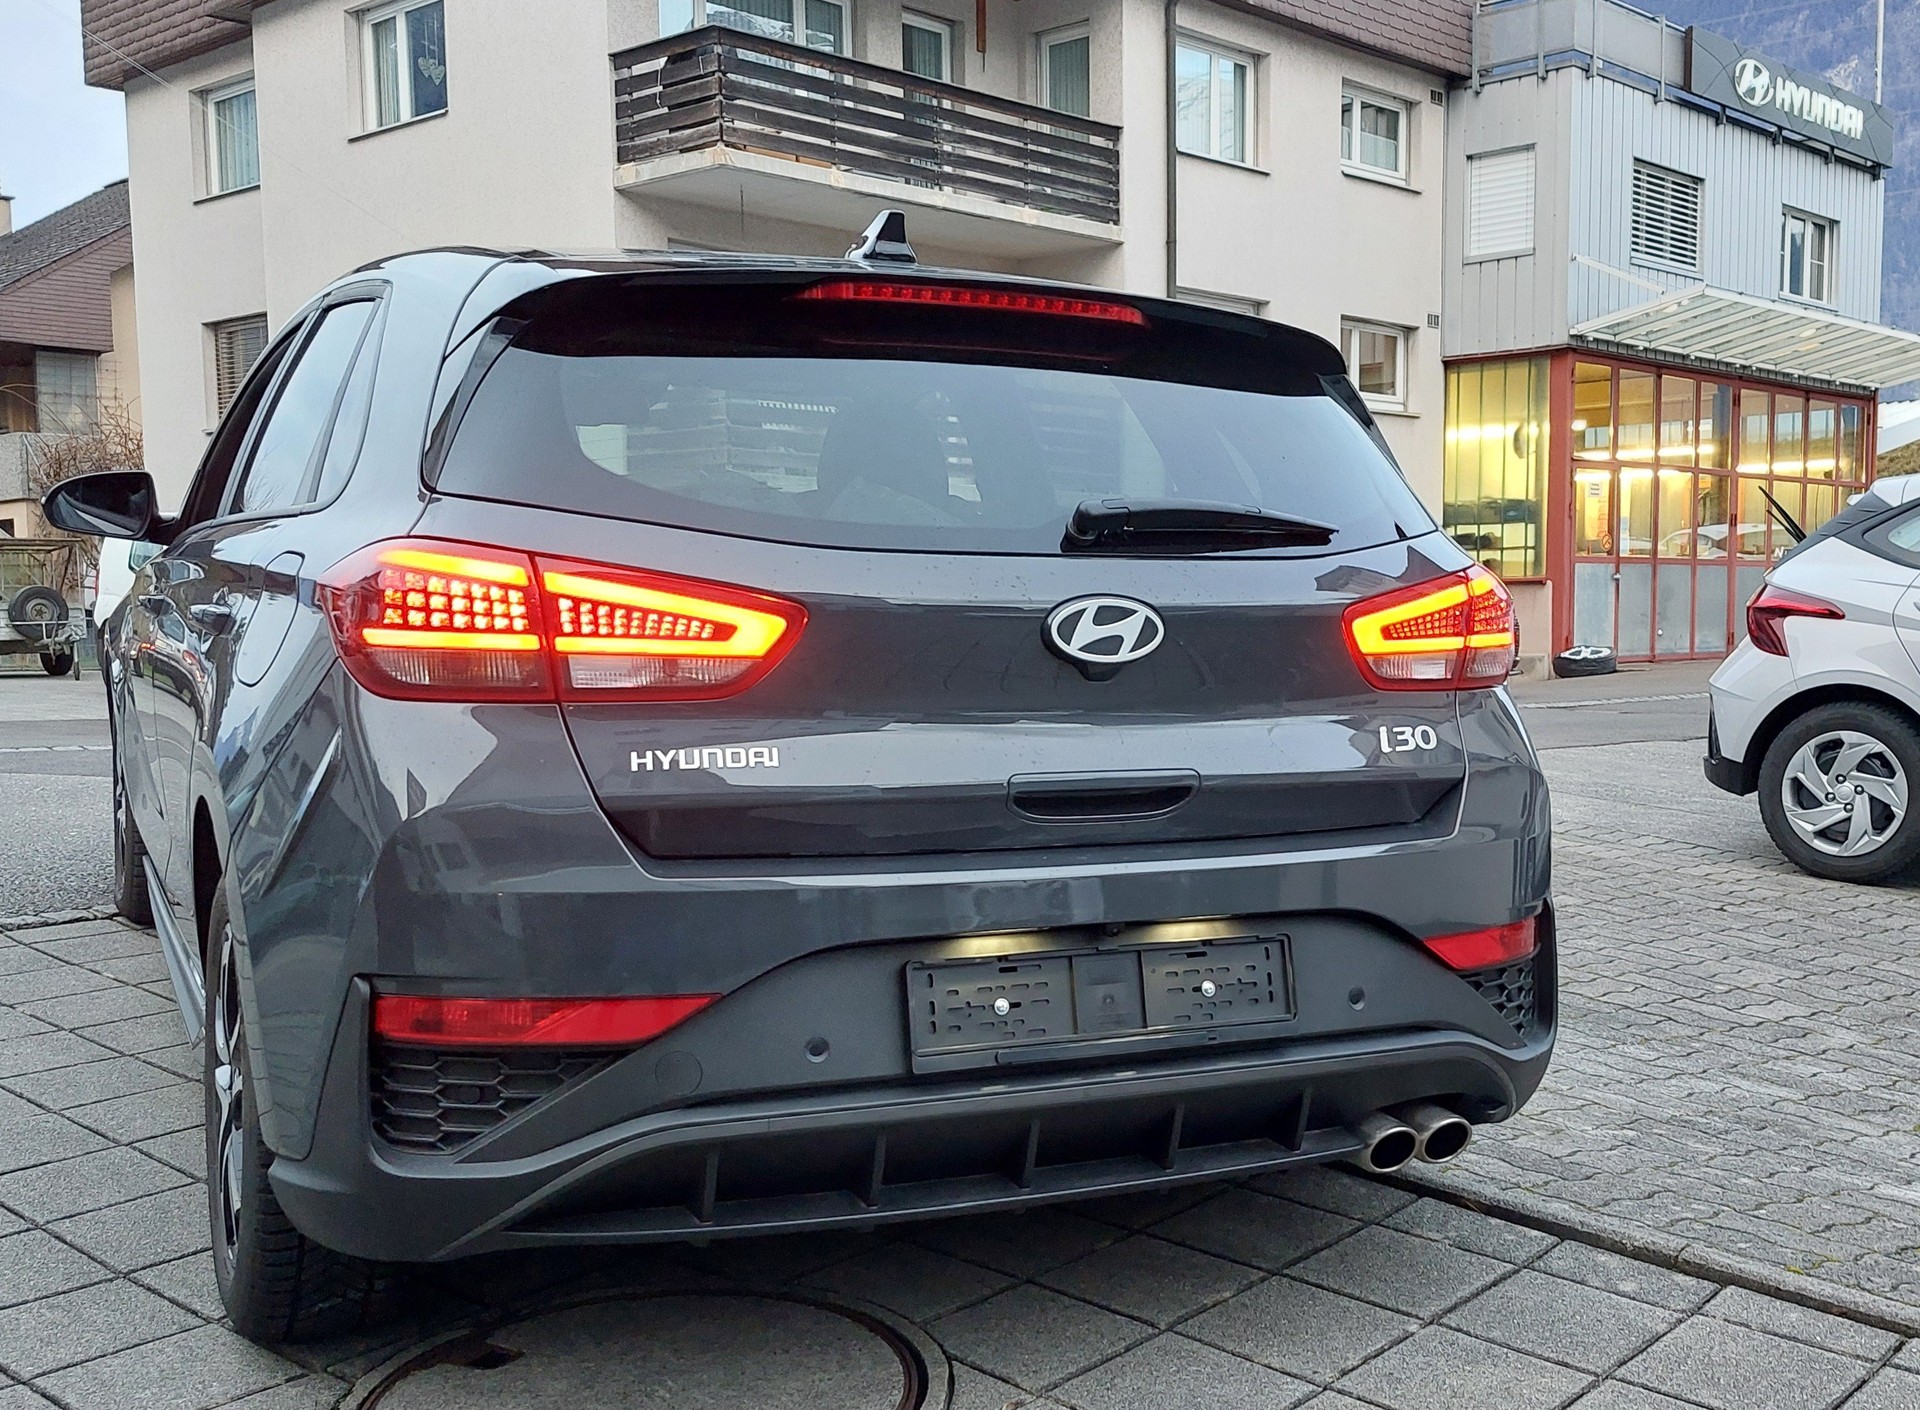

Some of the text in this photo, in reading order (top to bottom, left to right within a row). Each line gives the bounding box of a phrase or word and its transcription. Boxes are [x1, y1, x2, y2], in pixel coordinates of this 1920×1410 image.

[1775, 75, 1864, 141] HYUNDAI
[1379, 724, 1438, 754] i30
[630, 746, 780, 772] HYUNDAI
